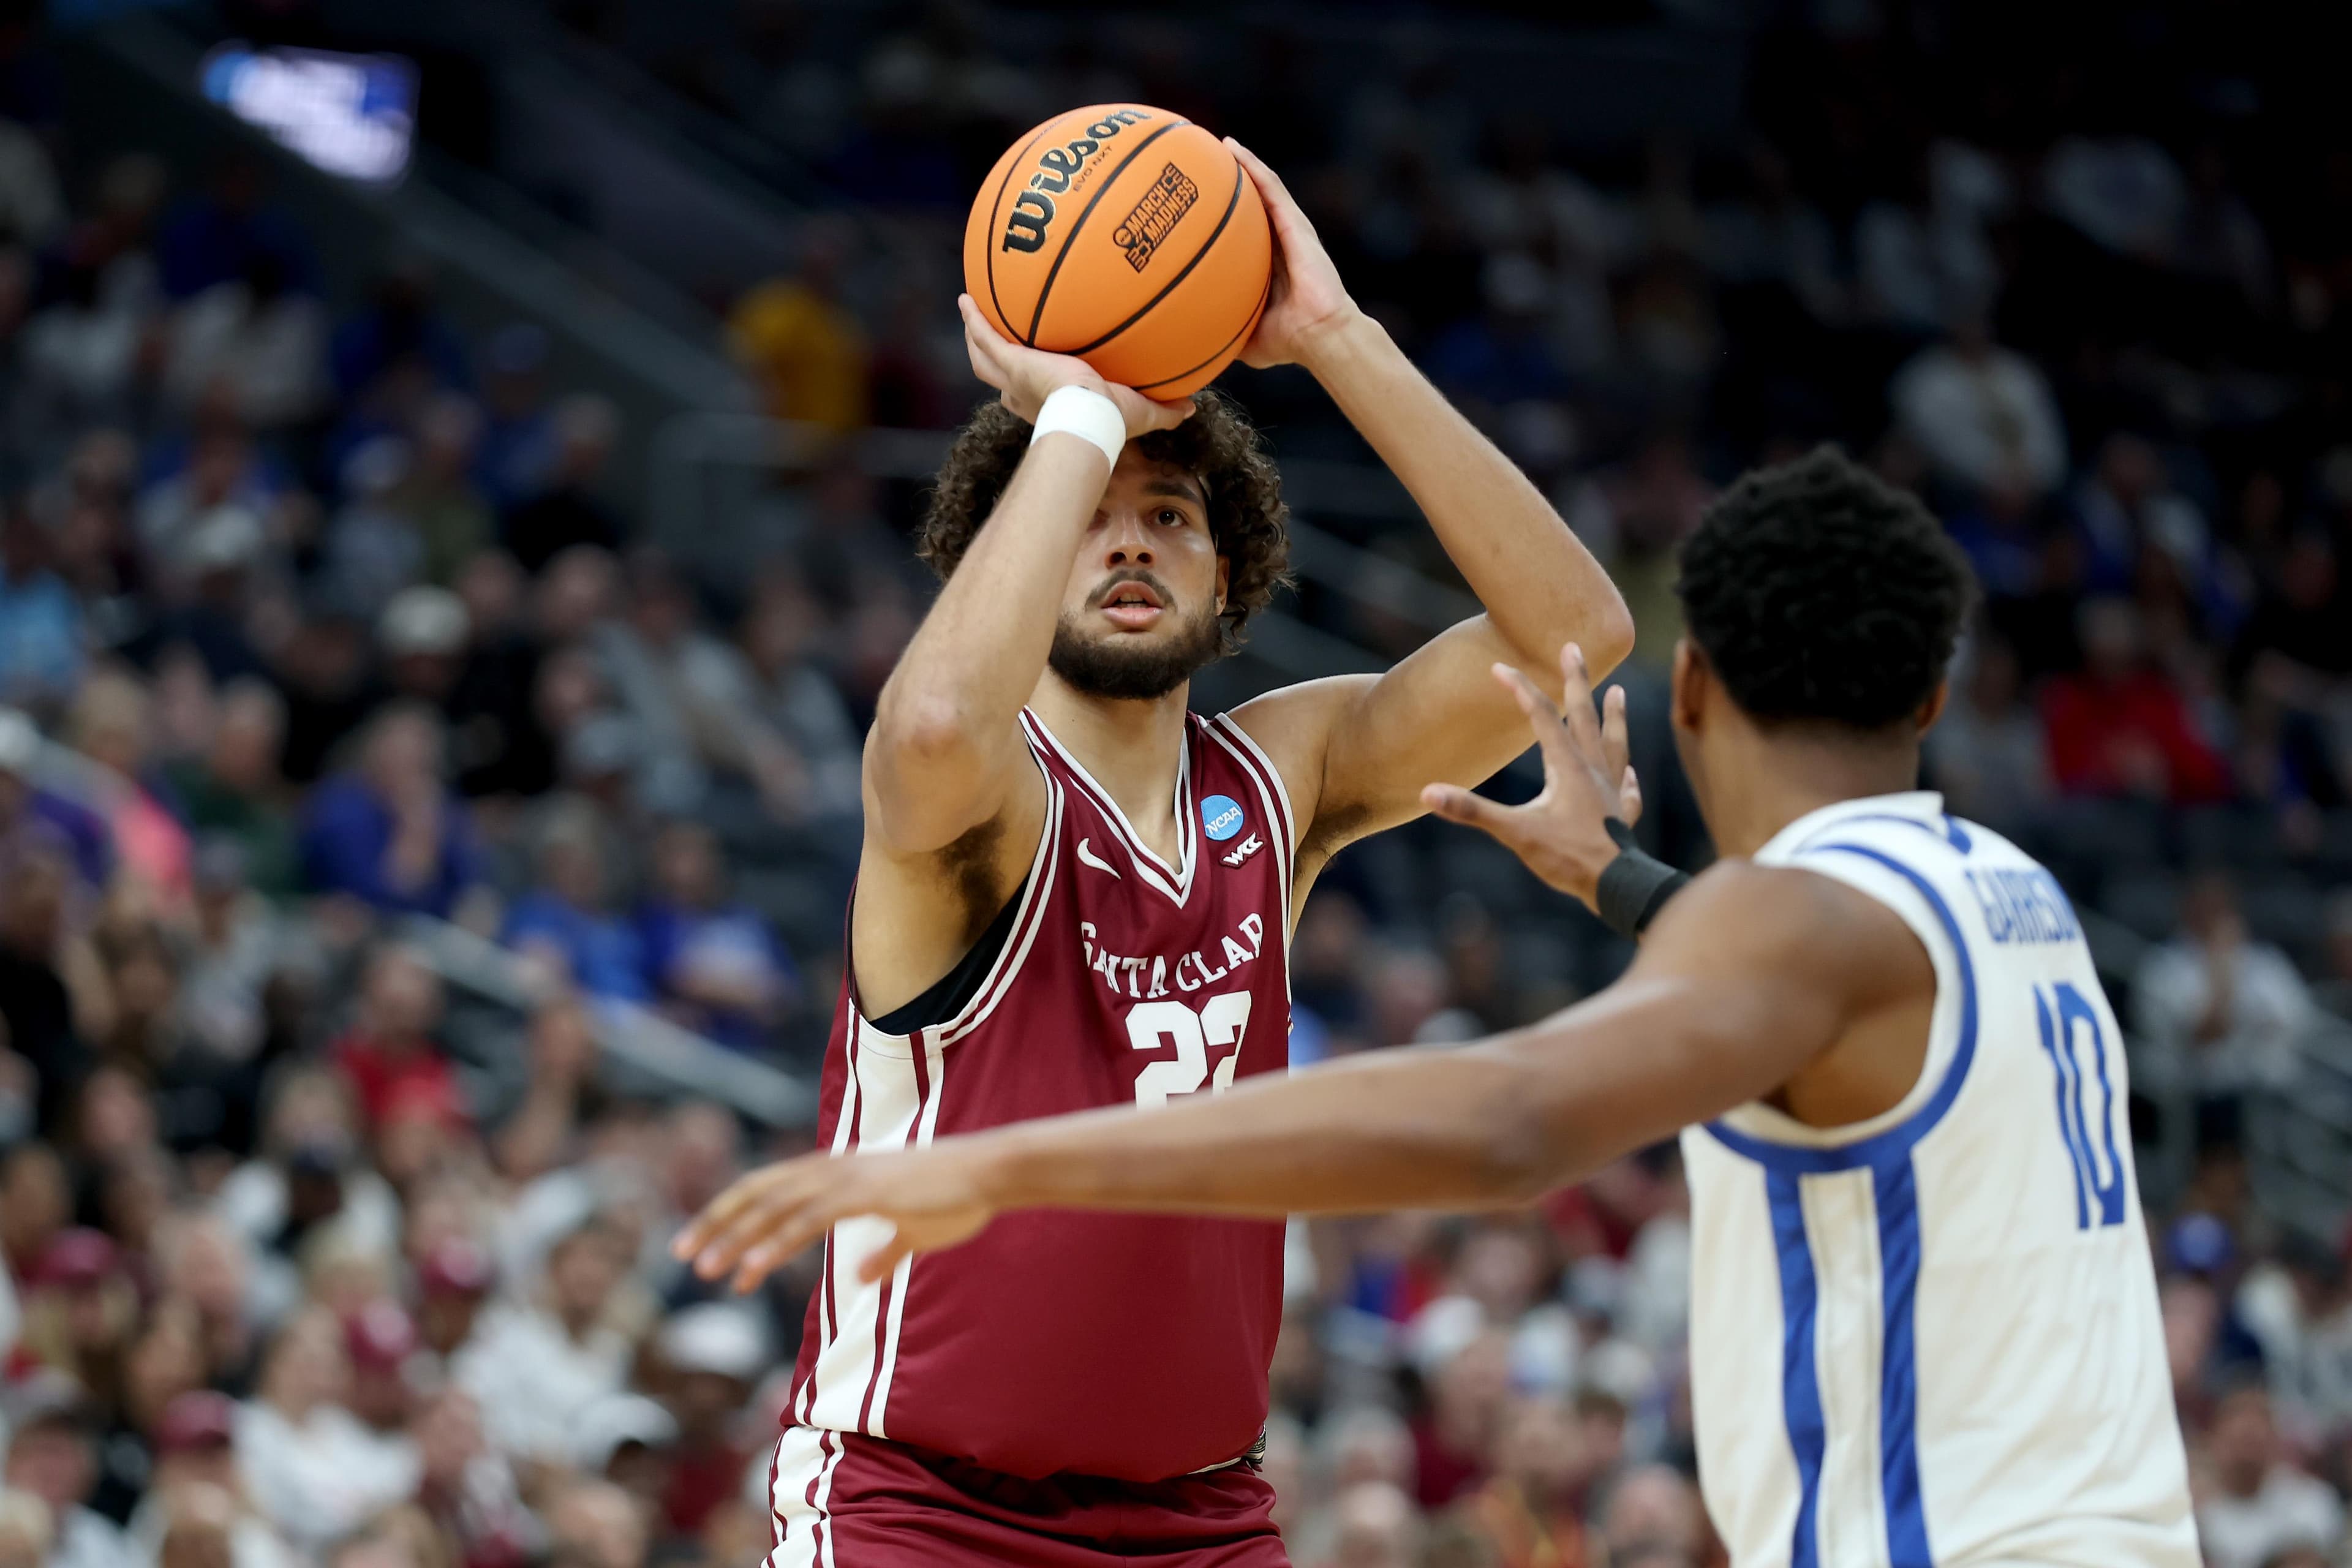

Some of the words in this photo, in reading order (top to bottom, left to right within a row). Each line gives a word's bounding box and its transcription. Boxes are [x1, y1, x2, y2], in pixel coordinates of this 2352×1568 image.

[1003, 109, 1152, 252] Wilson
[1125, 183, 1170, 239] MARCH
[1143, 177, 1196, 245] MADNESS
[1205, 806, 1242, 835] NCAA
[1176, 913, 1263, 992] CLAR
[2032, 982, 2124, 1231] 10
